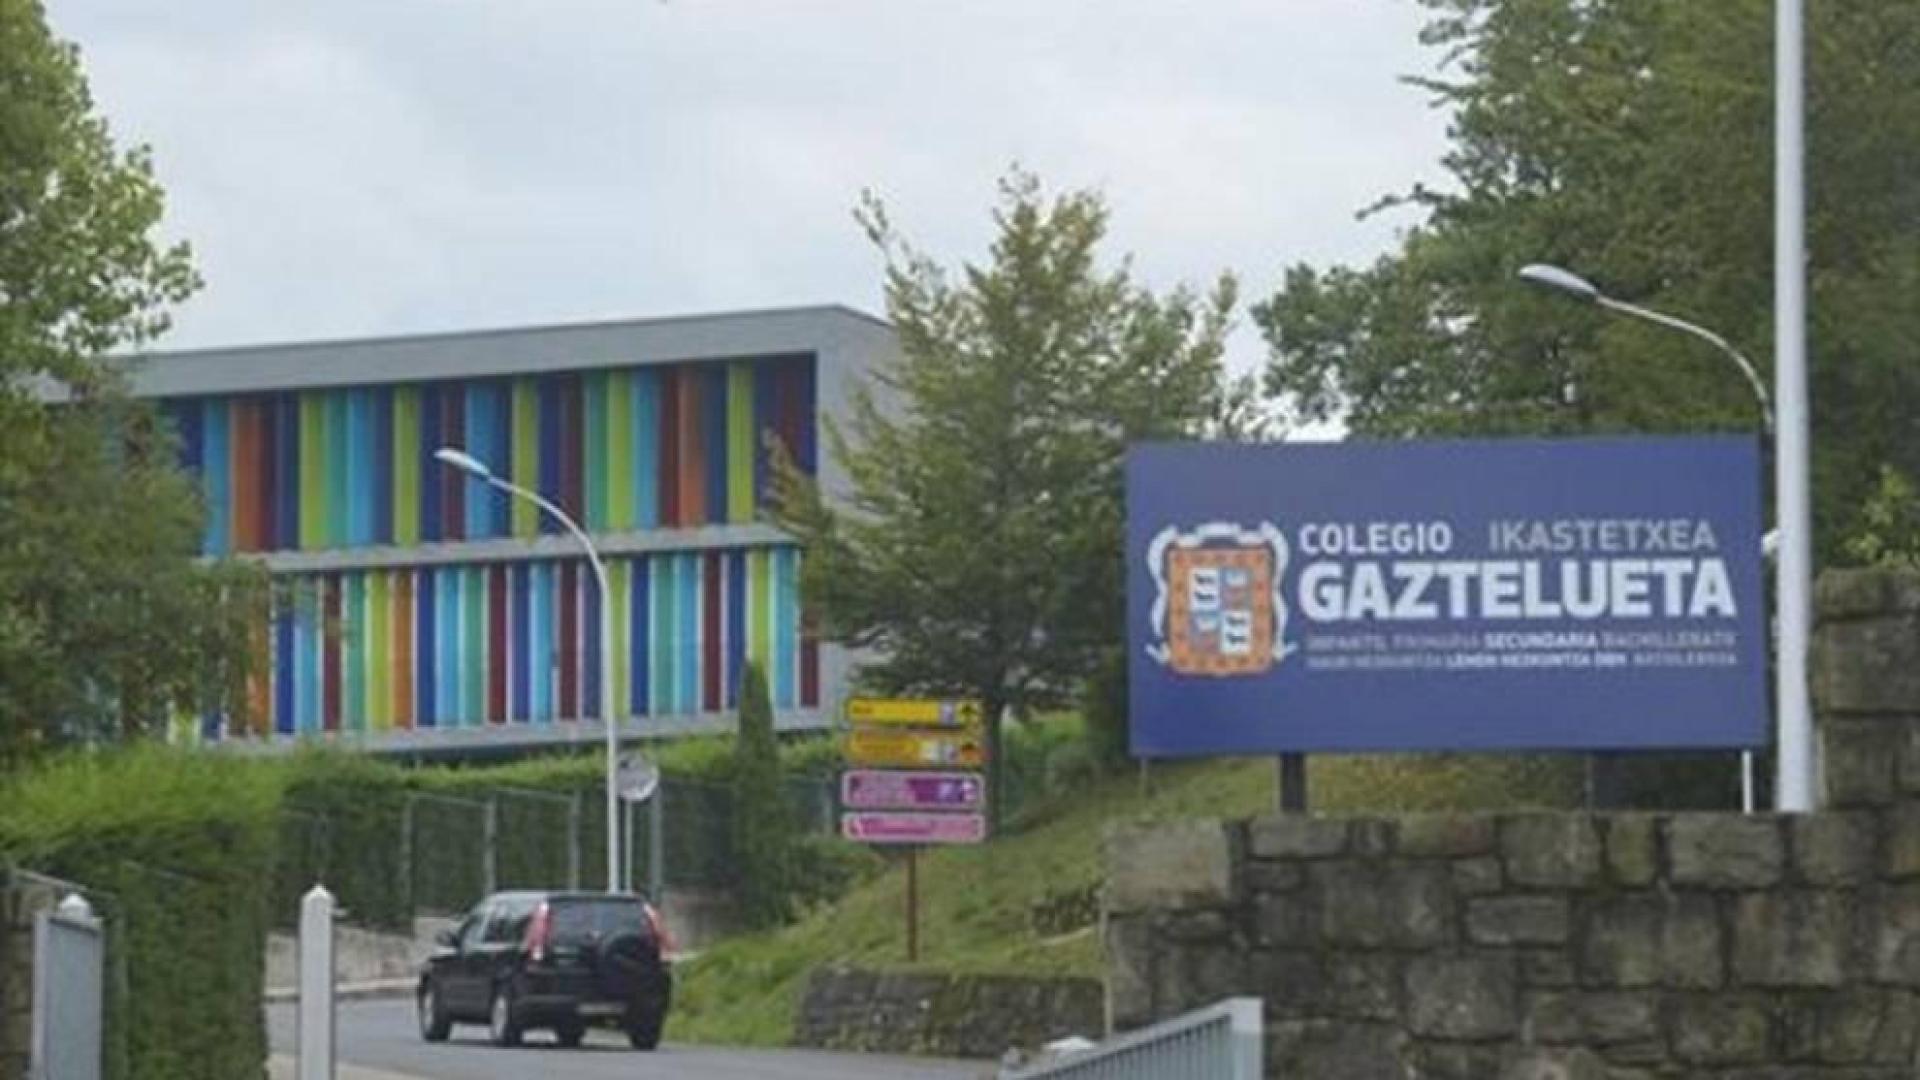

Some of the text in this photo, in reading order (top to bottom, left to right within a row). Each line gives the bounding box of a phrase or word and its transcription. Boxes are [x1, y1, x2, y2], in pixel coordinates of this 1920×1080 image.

[1300, 518, 1717, 554] COLEGIO IKASTETXEA
[1300, 558, 1737, 621] GAZTELUETA
